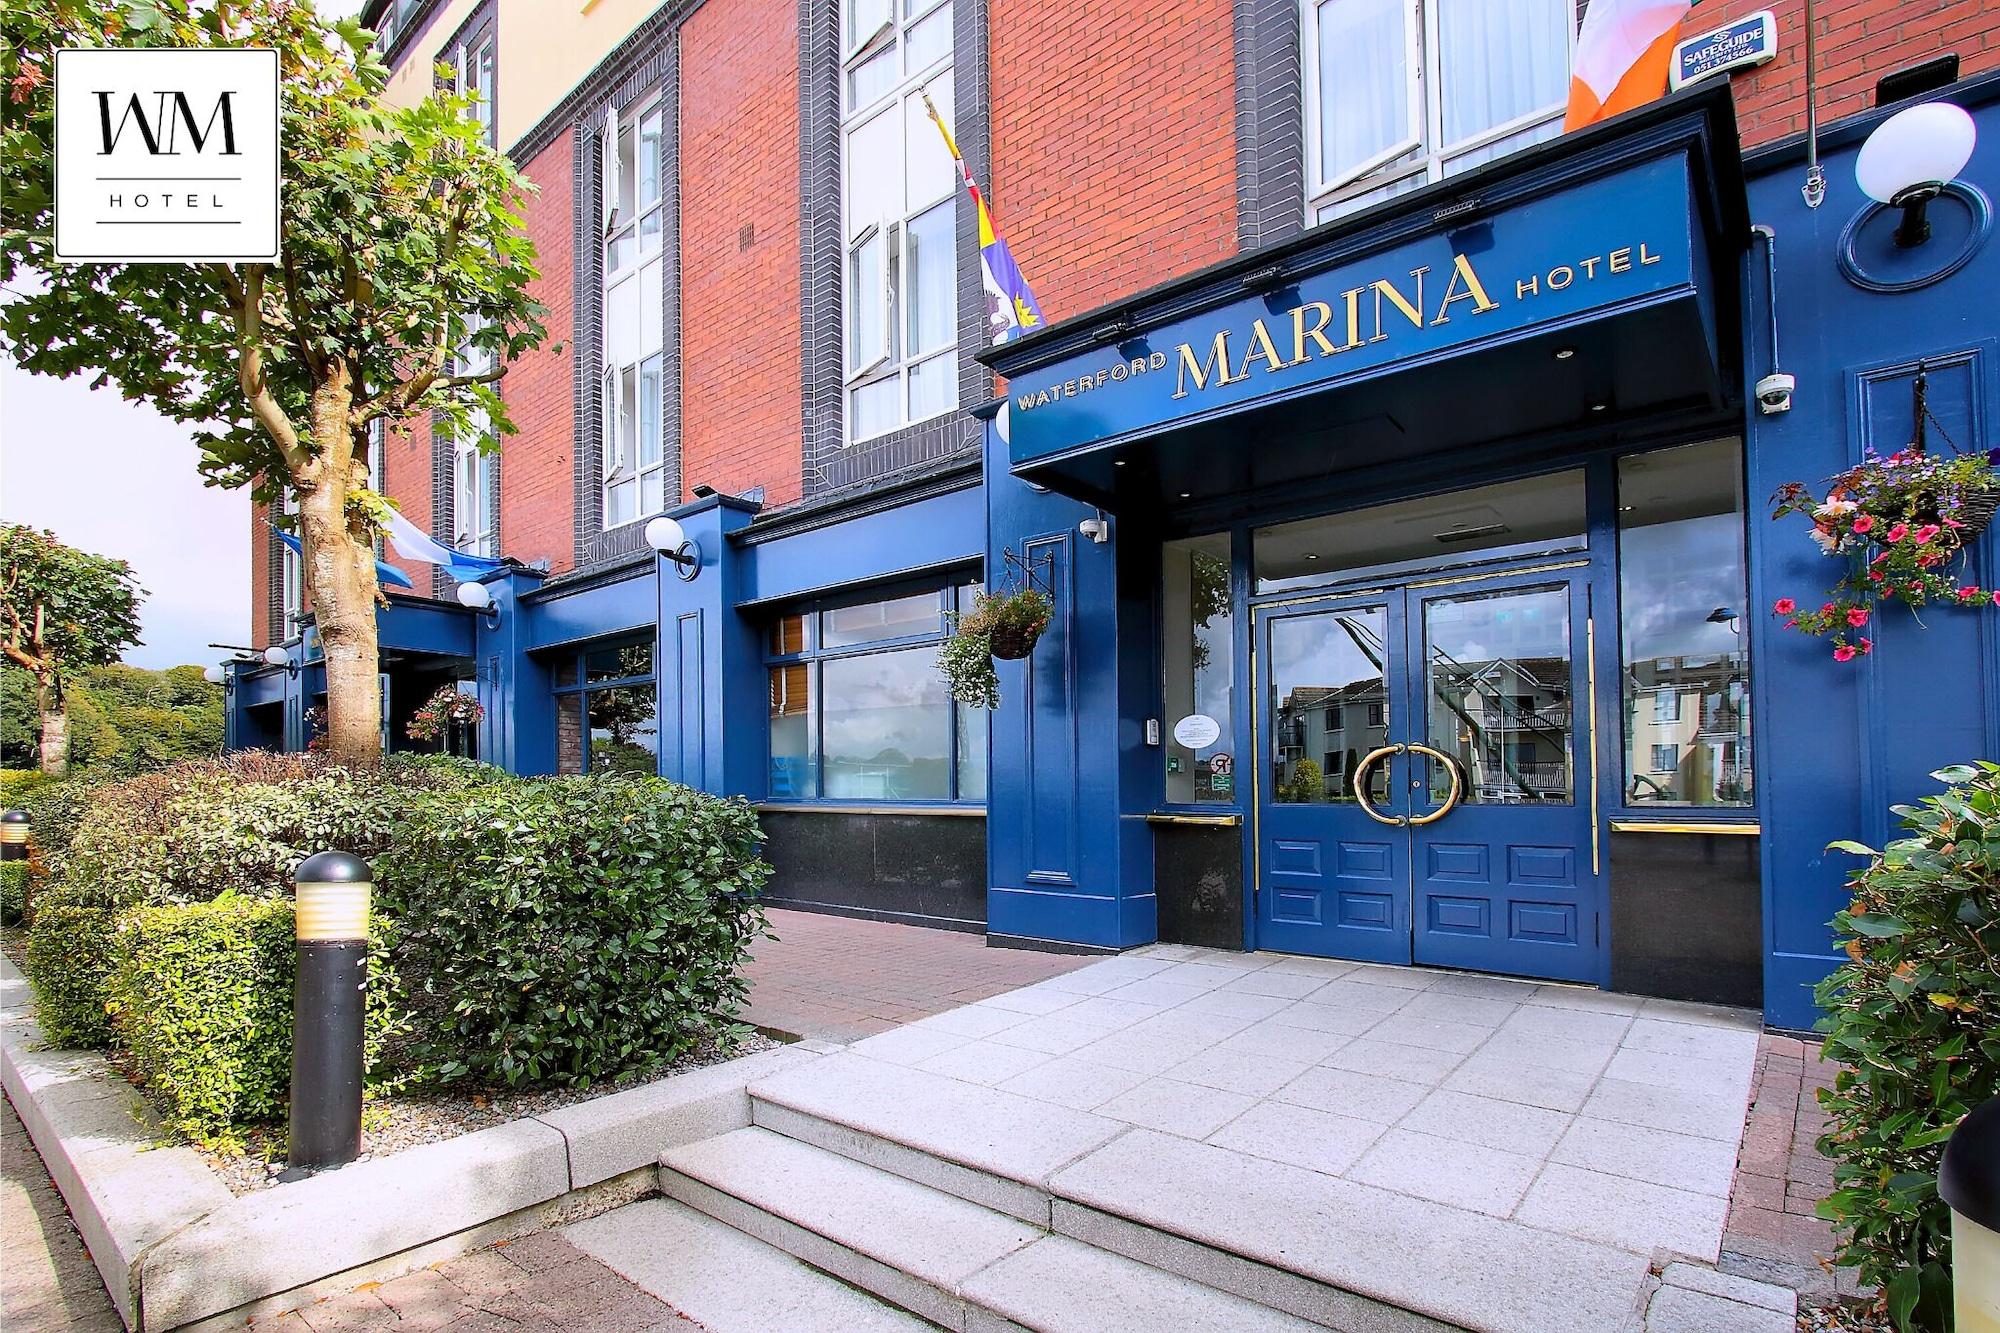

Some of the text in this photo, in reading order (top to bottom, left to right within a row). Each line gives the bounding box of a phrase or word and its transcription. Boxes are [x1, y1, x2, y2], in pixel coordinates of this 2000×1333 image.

[1684, 28, 1763, 66] SAFEGUIDE
[1694, 46, 1754, 74] 051 374566
[1017, 243, 1660, 412] WATERFORD MARINA HOTEL
